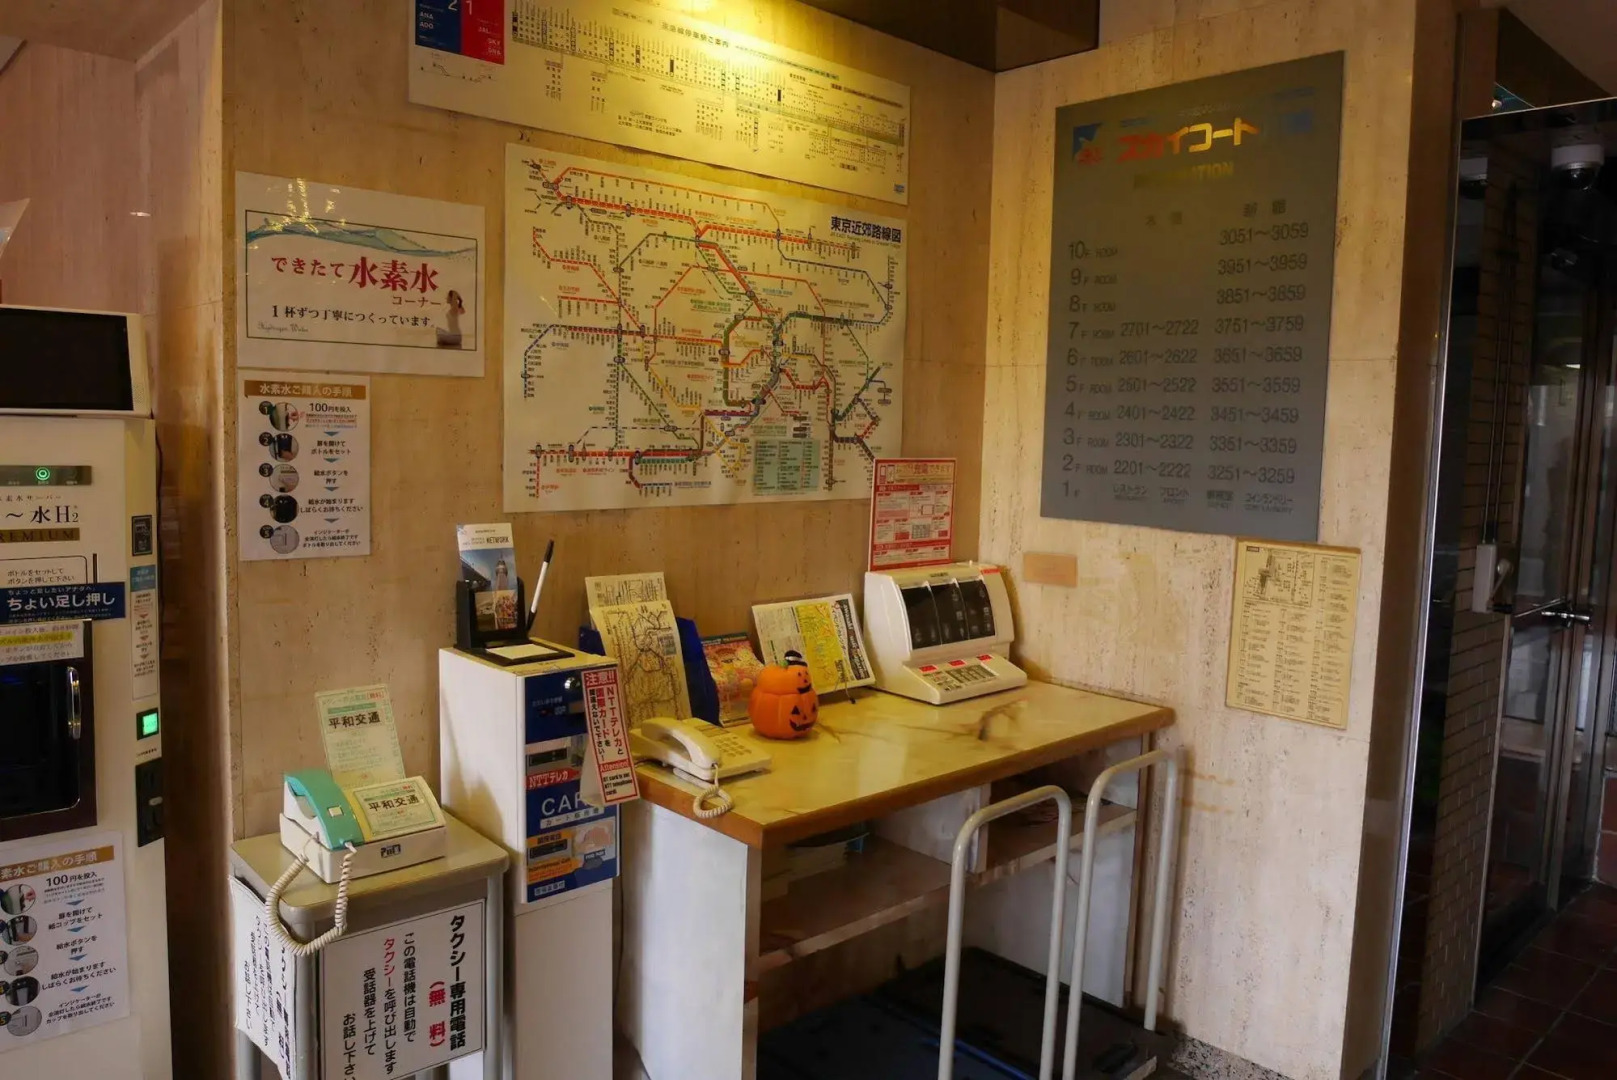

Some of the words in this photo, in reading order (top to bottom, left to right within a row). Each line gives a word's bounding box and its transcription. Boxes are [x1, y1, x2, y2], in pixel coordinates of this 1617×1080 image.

[831, 216, 902, 244] 東京近郊路線図
[272, 256, 440, 294] できたて水素水
[392, 295, 442, 308] コーナー
[260, 383, 352, 398] 水素水ご購入の手順
[309, 402, 352, 412] 100円を投入
[0, 494, 62, 502] 素水サーバー
[8, 592, 115, 611] ちょい足し押し
[328, 711, 380, 729] 平和交通
[529, 770, 568, 789] NTTテレカ
[368, 794, 420, 812] 平和交通
[46, 871, 98, 886] 100円を投入
[56, 935, 98, 950] 給水ボタンを
[42, 967, 116, 990] しばらくお待ちください
[51, 962, 105, 980] 給水が始まります
[404, 932, 416, 1042] この電話機は自動で
[450, 915, 466, 1051] タクシー専用電話
[364, 968, 376, 1056] 受話器を上げて
[384, 938, 396, 1074] タクシーを呼び出します
[343, 1014, 356, 1080] お話し下さ
